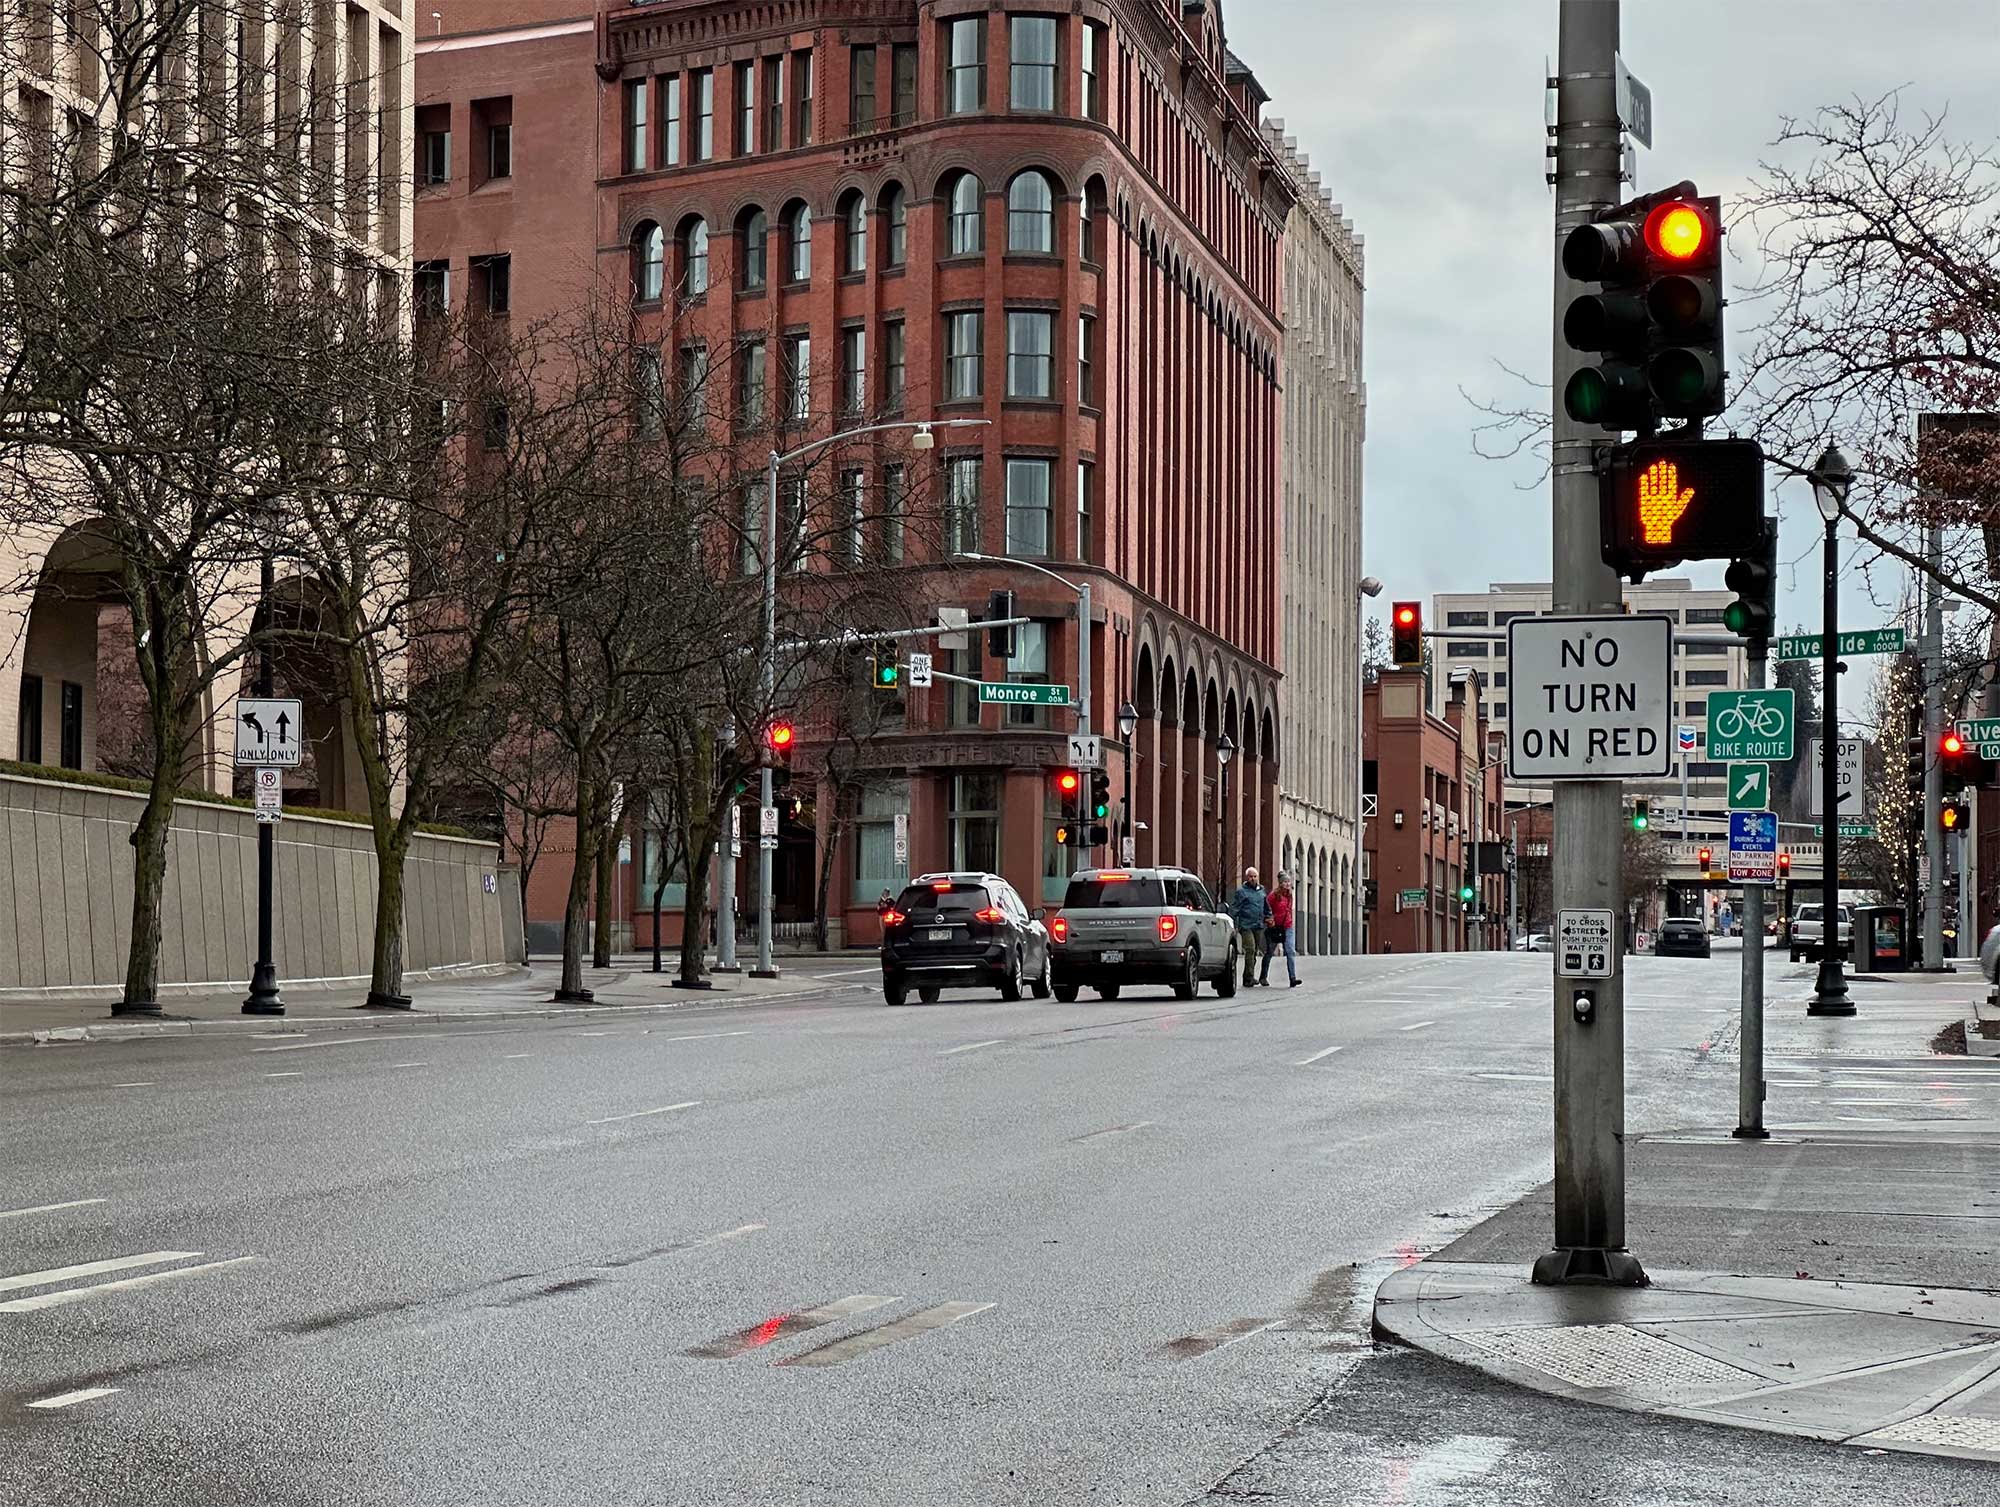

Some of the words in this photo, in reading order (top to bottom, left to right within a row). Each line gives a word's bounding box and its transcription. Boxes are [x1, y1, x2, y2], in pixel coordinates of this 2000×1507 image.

[1781, 636, 1866, 657] Riveide
[1877, 631, 1896, 641] Ave
[1873, 641, 1900, 652] 1000W
[1561, 637, 1619, 668] NO
[914, 656, 929, 665] ONE
[913, 665, 930, 673] WAY
[986, 685, 1037, 701] Monroe
[1050, 687, 1060, 696] St
[1542, 683, 1636, 713] TURN
[1522, 728, 1569, 759] ON
[1588, 727, 1657, 757] RED
[240, 749, 266, 760] ONLY
[271, 749, 297, 760] ONLY
[1714, 742, 1741, 757] BIKE
[1746, 741, 1786, 756] ROUTE
[1818, 744, 1857, 756] SOP
[1818, 827, 1863, 835] Sague
[1744, 852, 1774, 860] PARKING
[1731, 868, 1749, 876] TOW
[1751, 869, 1773, 877] ZONE
[1571, 927, 1599, 935] STREET
